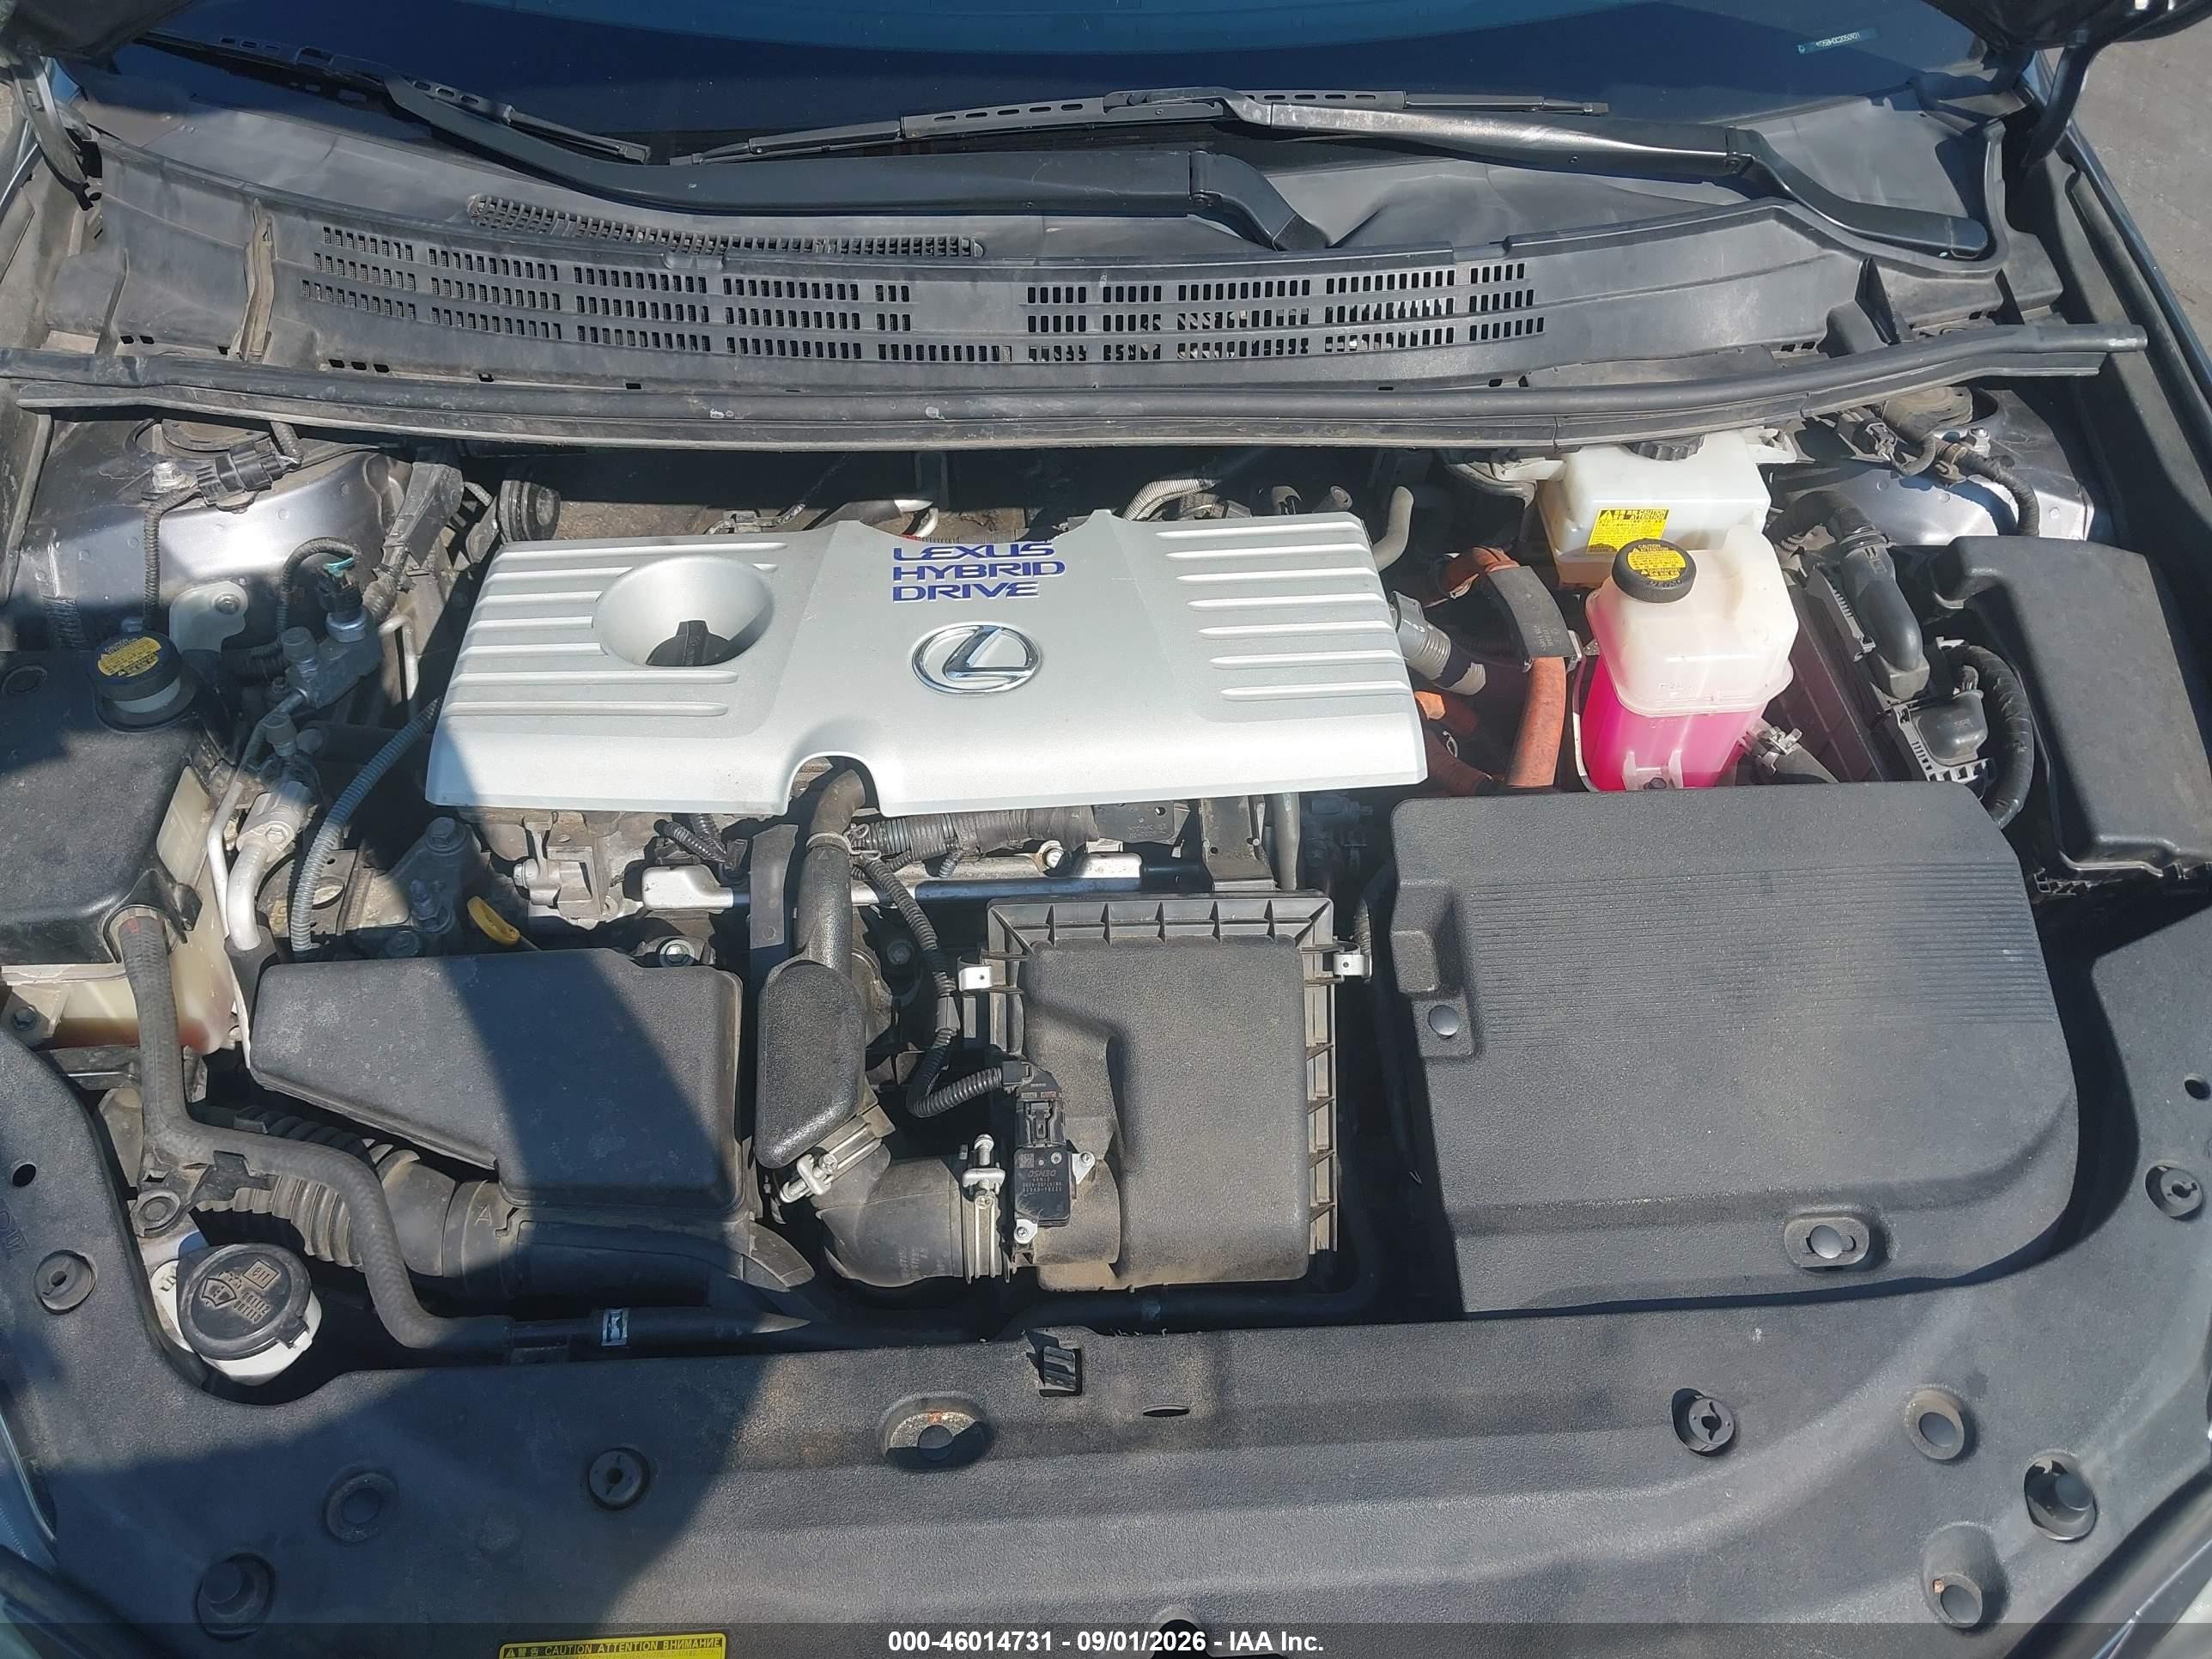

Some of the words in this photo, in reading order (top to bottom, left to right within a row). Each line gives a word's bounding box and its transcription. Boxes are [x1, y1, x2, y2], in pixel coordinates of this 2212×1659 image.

[893, 543, 1055, 561] LEXUS
[893, 561, 1066, 581] HYBRID
[893, 581, 1040, 603] DRIVE
[544, 1644, 592, 1656] CAUTION
[597, 1641, 659, 1653] ATTENTION
[663, 1638, 721, 1650] ВНИМАНИЕ
